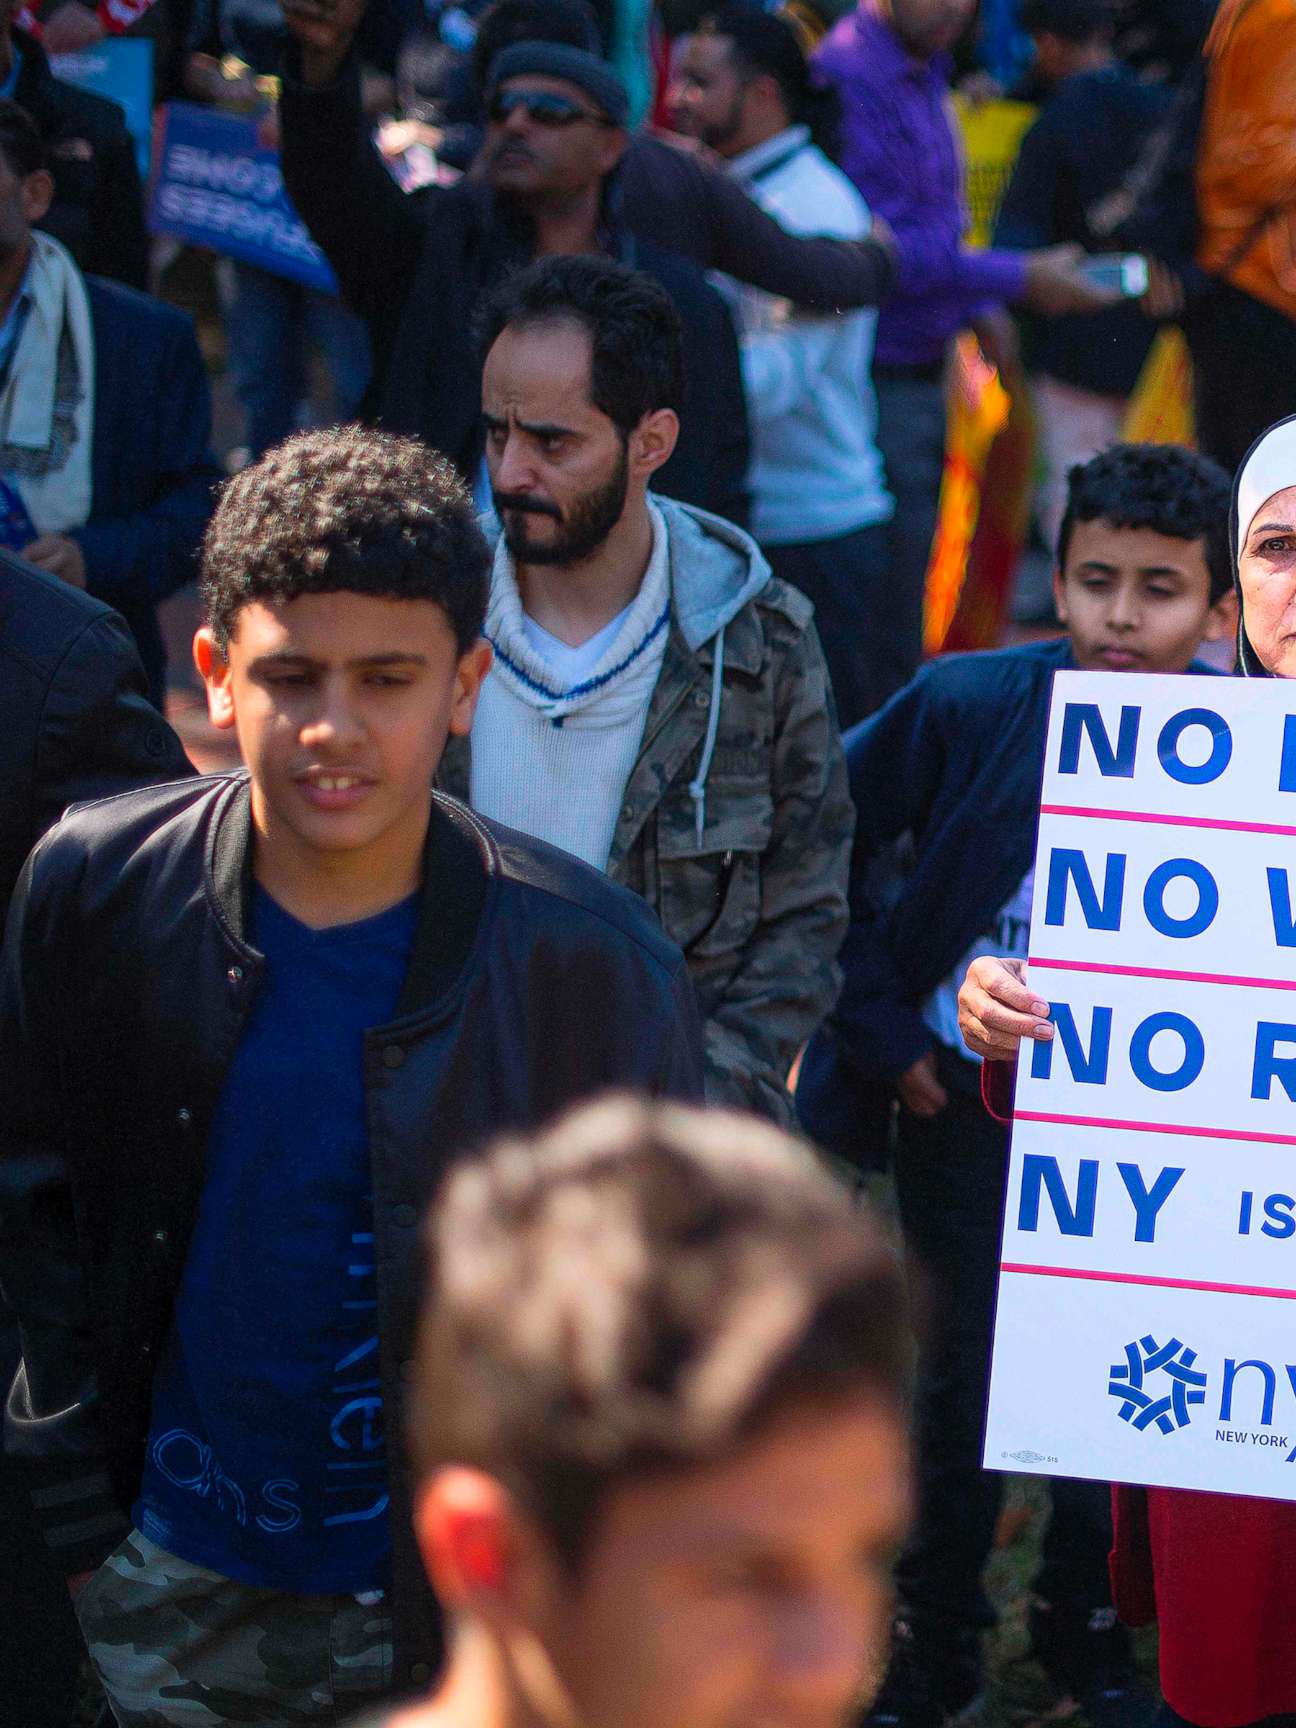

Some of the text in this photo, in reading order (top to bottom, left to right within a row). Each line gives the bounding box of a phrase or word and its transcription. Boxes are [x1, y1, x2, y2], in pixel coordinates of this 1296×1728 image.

[1058, 702, 1233, 785] NO
[1044, 847, 1220, 939] NO
[1030, 1001, 1206, 1093] NO
[1017, 1153, 1186, 1244] NY
[1237, 1190, 1296, 1240] IS
[1215, 1429, 1248, 1444] NEW
[1251, 1433, 1289, 1448] YORK
